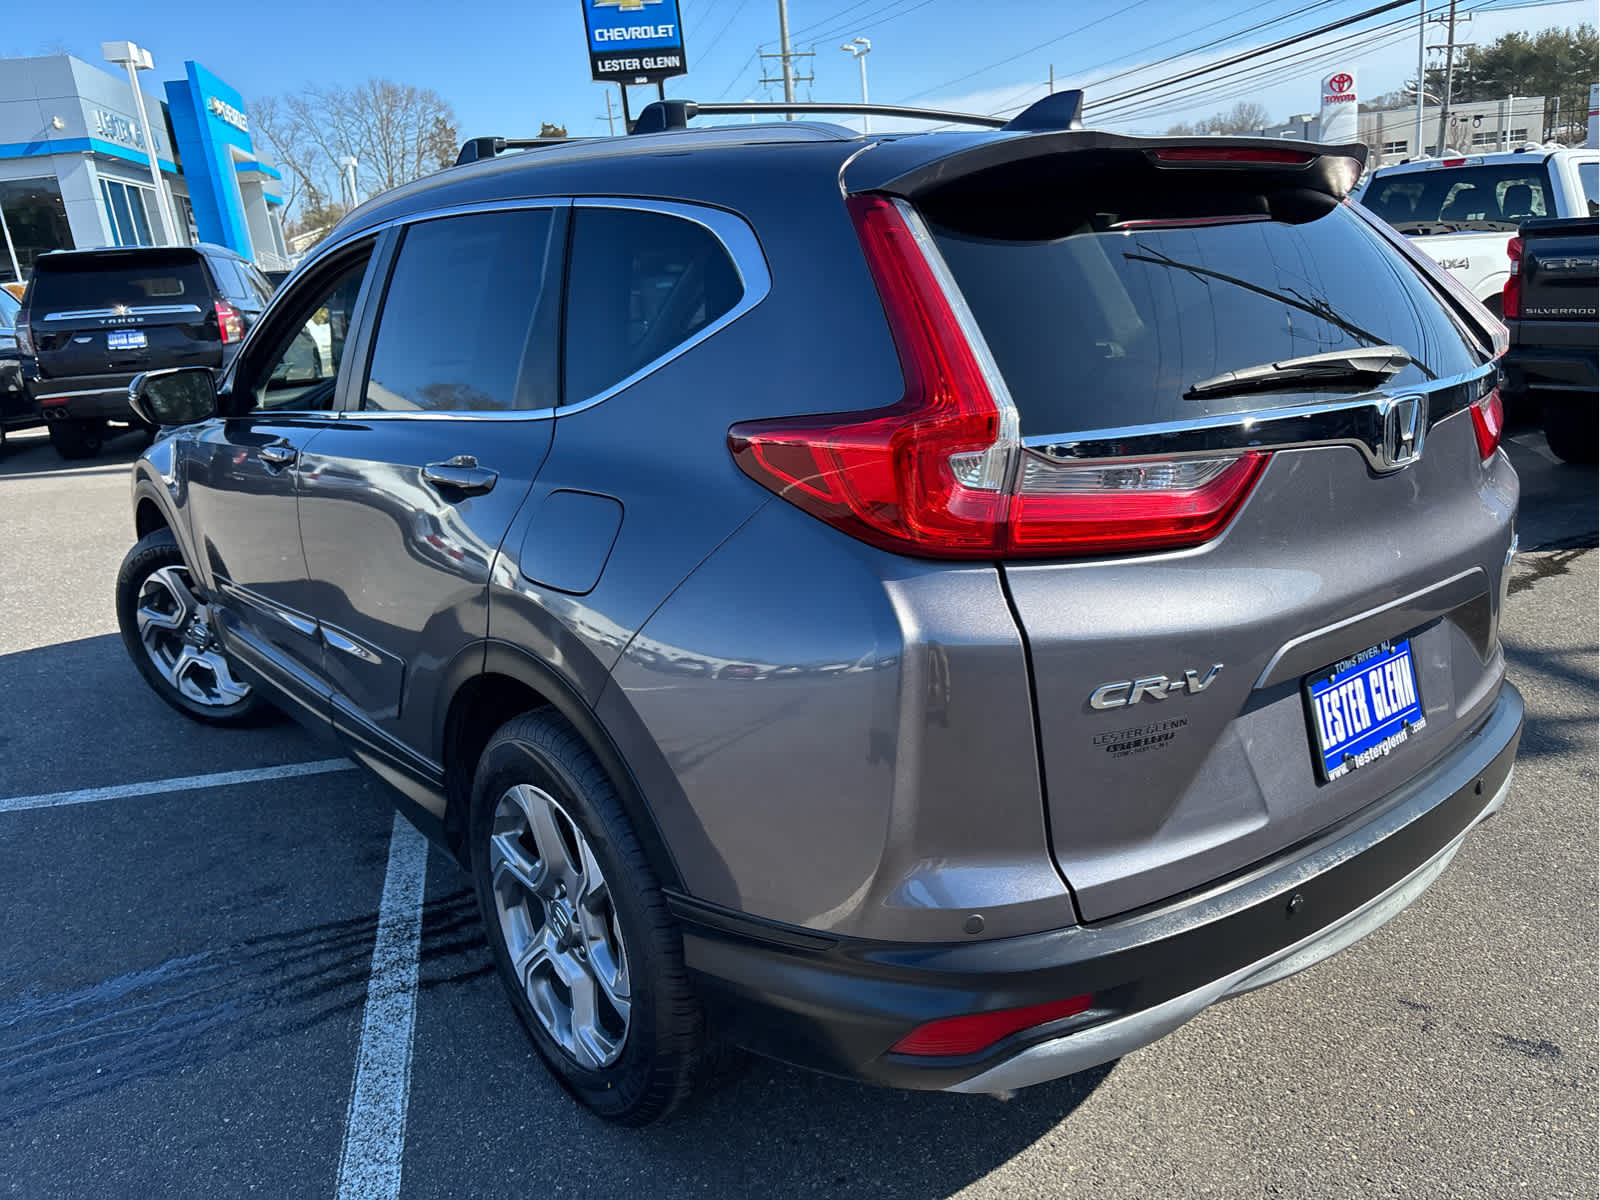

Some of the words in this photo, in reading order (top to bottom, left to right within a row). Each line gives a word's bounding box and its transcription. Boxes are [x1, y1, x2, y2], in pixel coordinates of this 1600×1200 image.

[594, 24, 675, 42] CHEVROLET
[597, 58, 640, 72] LESTER
[642, 56, 680, 69] GLENN
[1325, 94, 1356, 103] TOYOTA
[1335, 656, 1357, 674] TOMS
[1381, 640, 1391, 650] NJ
[1090, 663, 1224, 710] CR-V
[1314, 677, 1372, 751] LESTER
[1368, 654, 1416, 721] GLENN
[1092, 728, 1142, 745] LESTER
[1146, 718, 1188, 734] GLENN
